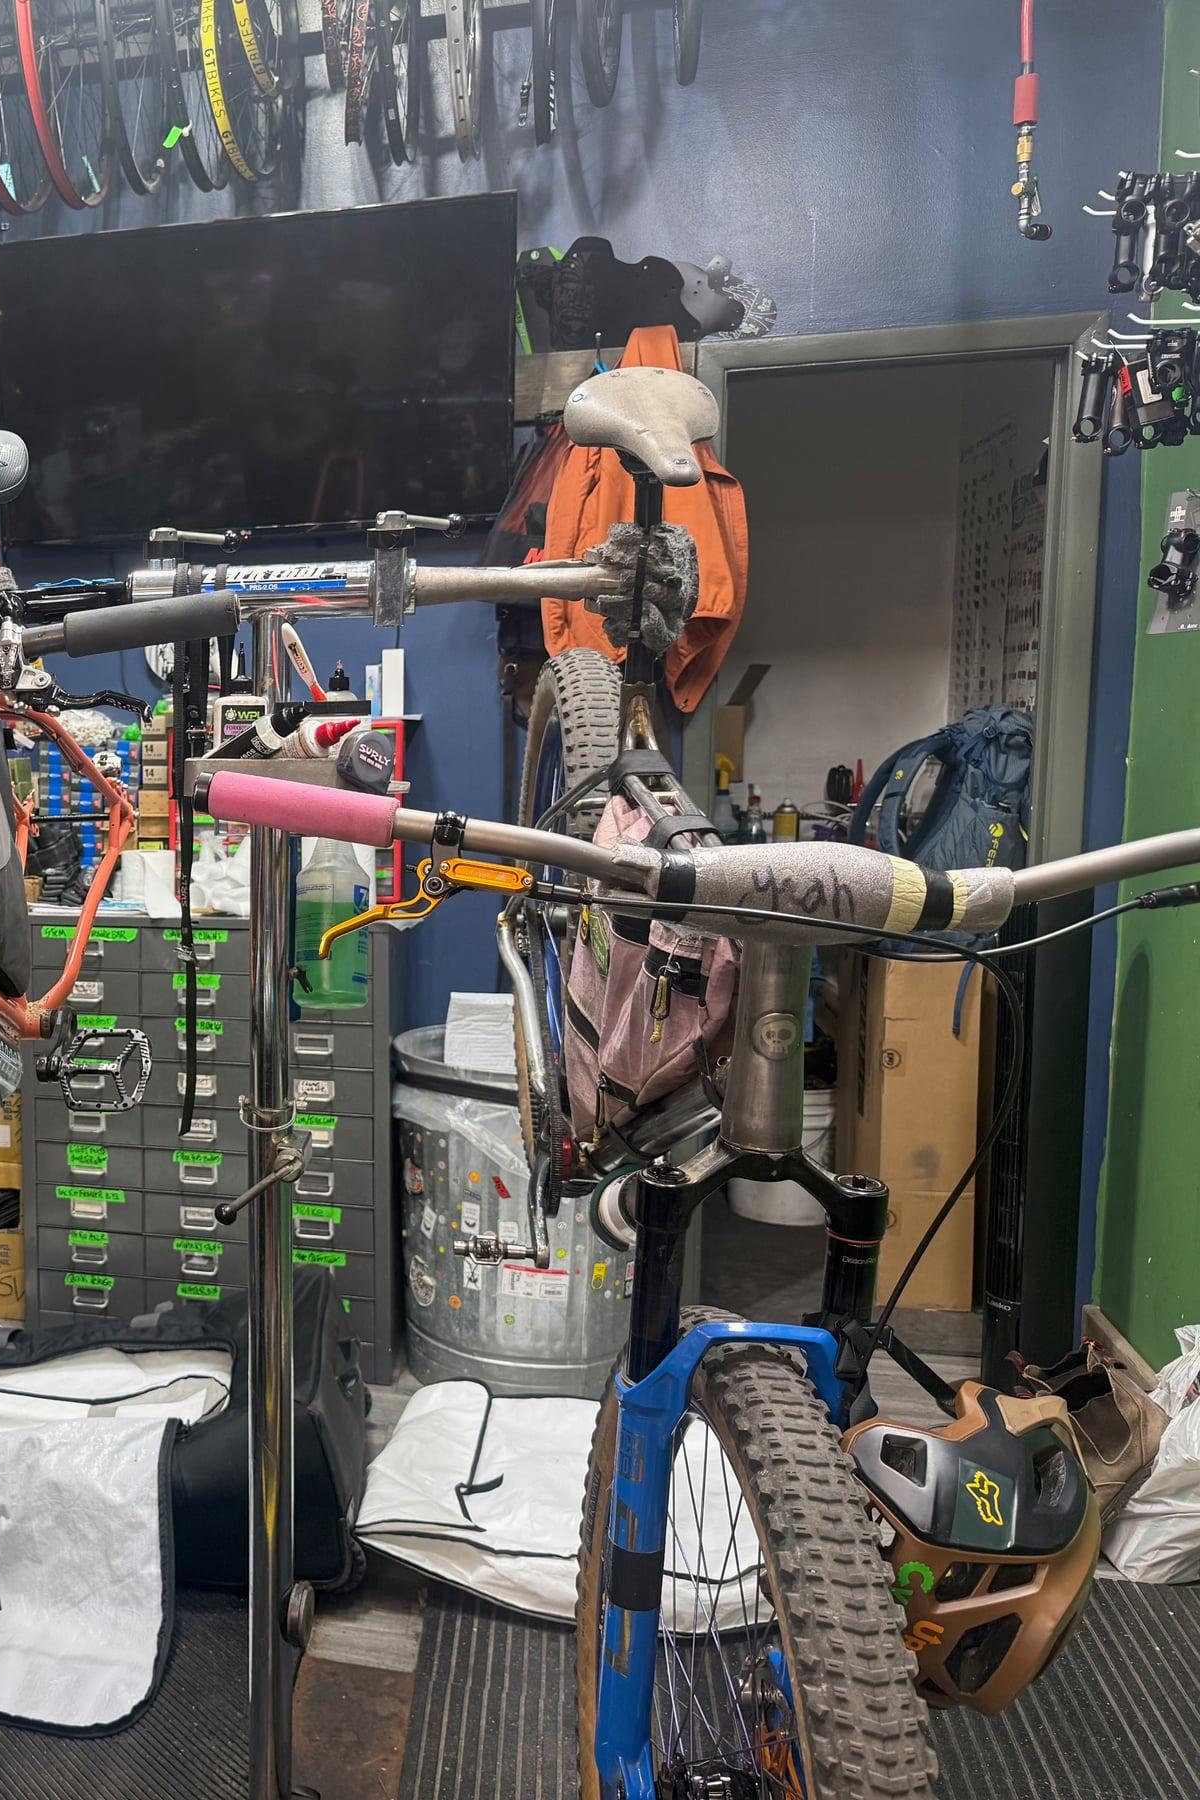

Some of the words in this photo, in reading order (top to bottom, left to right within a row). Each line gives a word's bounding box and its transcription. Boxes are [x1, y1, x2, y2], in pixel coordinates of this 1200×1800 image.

[204, 48, 226, 119] GTBIKES
[359, 743, 391, 766] SURLY
[734, 864, 855, 925] yeah
